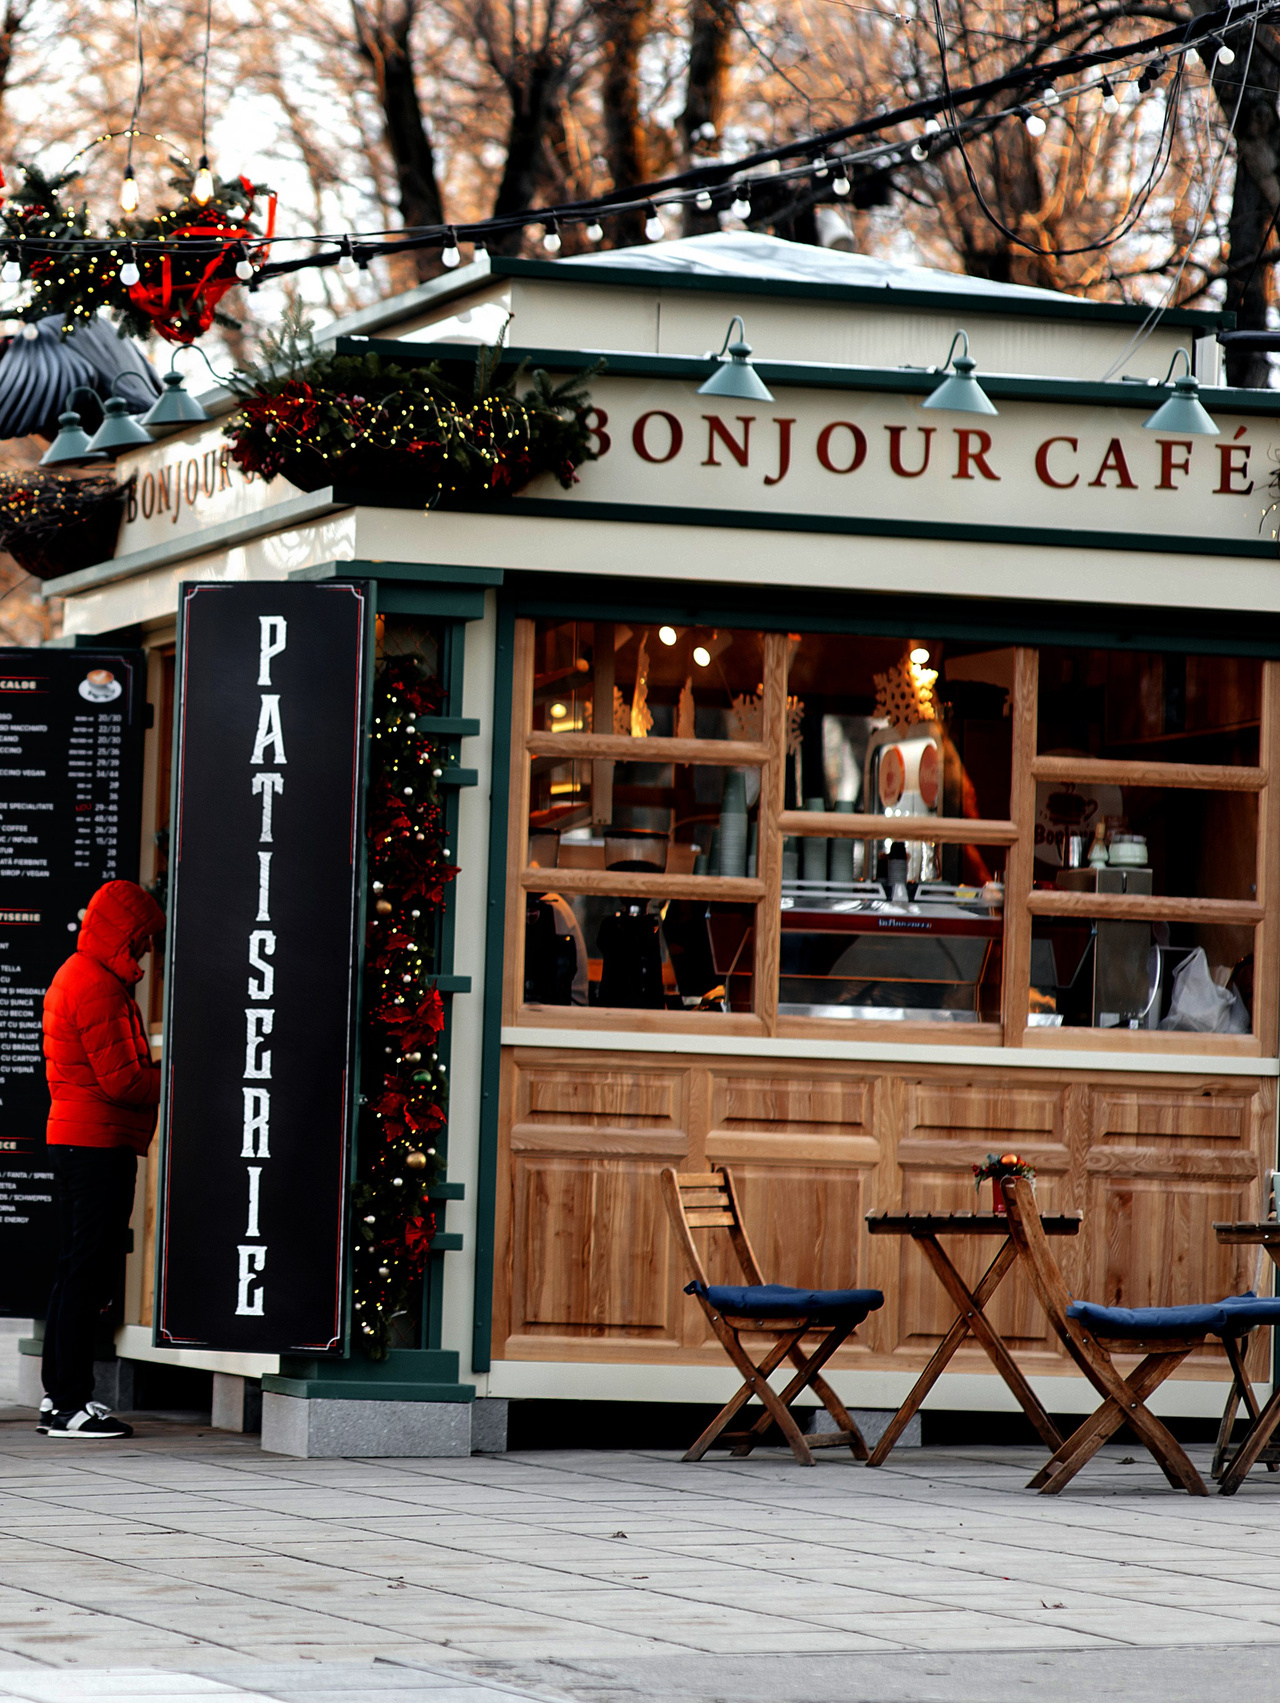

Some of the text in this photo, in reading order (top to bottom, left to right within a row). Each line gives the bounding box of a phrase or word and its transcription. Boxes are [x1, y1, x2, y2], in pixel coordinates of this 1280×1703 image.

[1035, 425, 1254, 495] CAFÉ
[0, 681, 36, 689] CALDE
[9, 803, 54, 811] SPECIALITATE
[94, 815, 118, 823] 48/68
[12, 836, 38, 844] INFUZIE
[14, 858, 47, 866] FIERBINTE
[0, 869, 20, 877] SIROP
[234, 615, 288, 1316] PATISERIE
[7, 1171, 27, 1179] FANTA
[34, 1172, 54, 1180] SPRITE
[14, 1194, 52, 1202] SCHWEPPES
[4, 1216, 29, 1224] ENERGY
